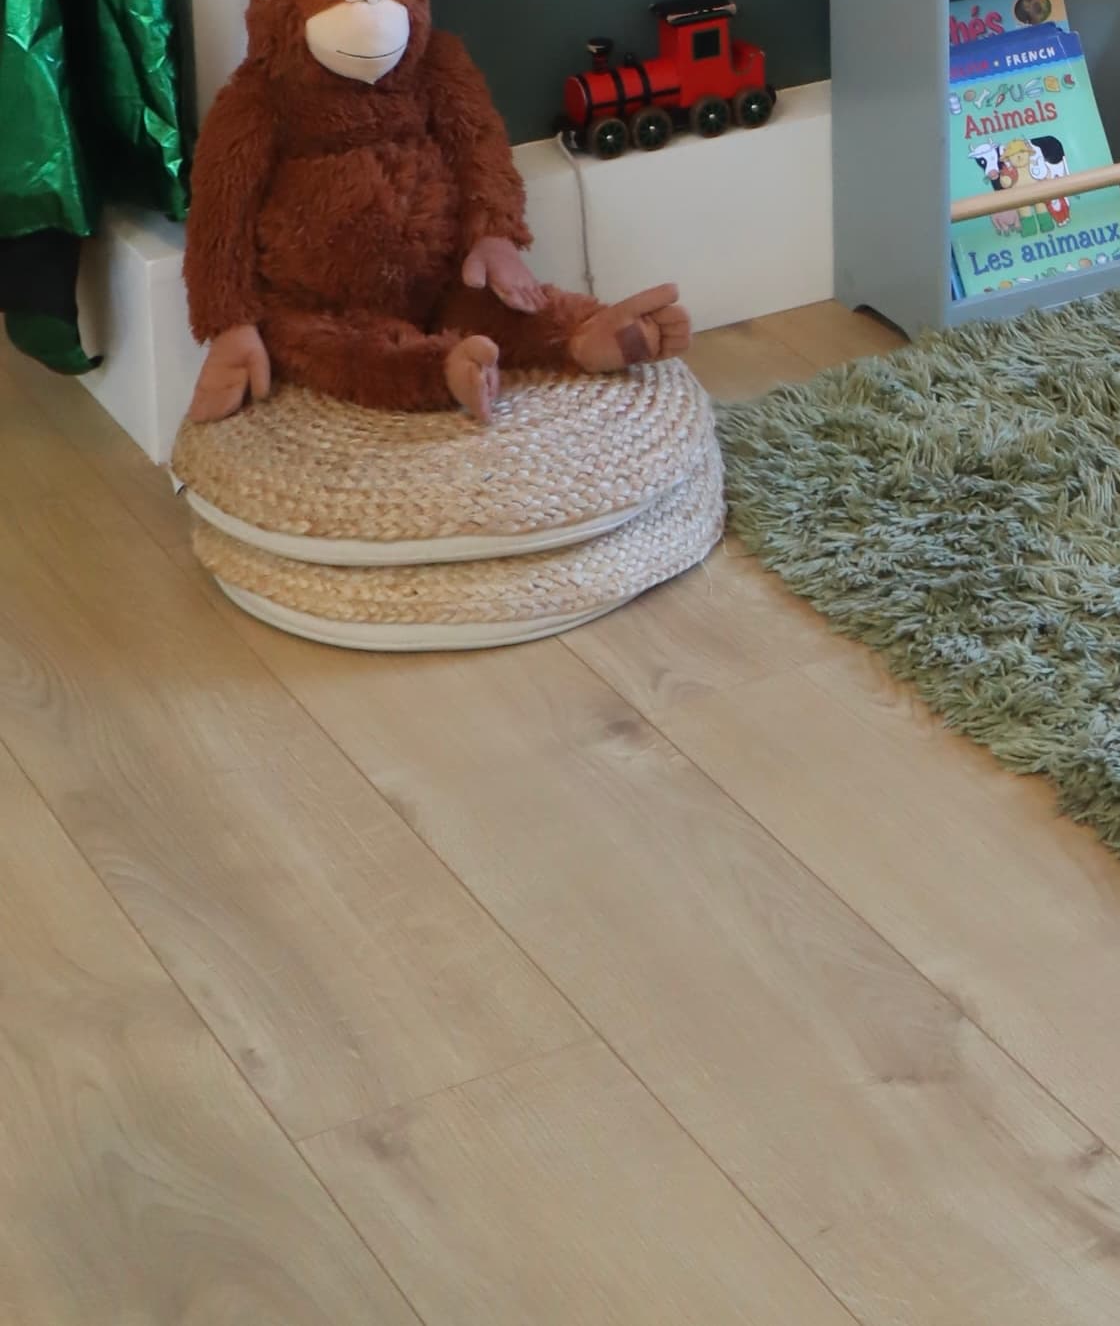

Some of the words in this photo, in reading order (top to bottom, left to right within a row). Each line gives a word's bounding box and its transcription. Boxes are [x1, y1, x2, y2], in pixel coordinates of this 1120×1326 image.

[1004, 46, 1056, 67] FRENCH
[964, 99, 1058, 139] Animals
[968, 249, 1014, 277] Les
